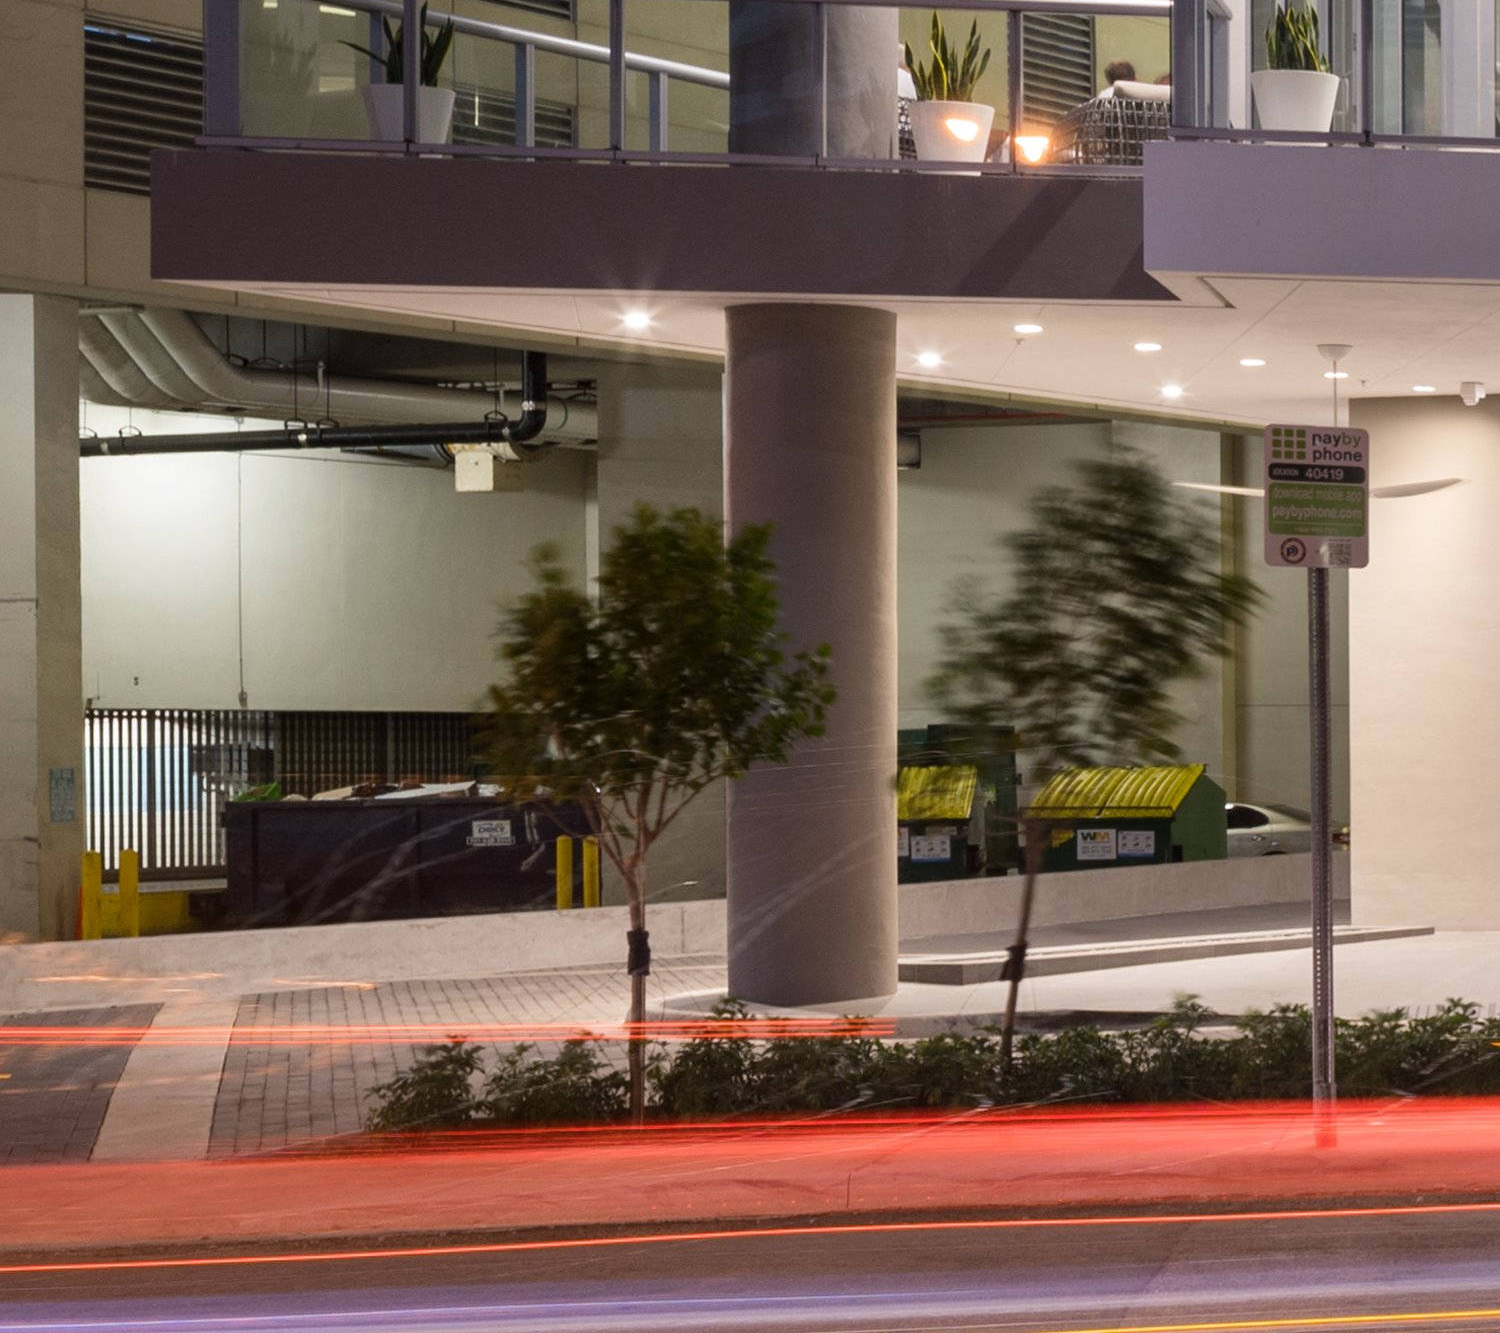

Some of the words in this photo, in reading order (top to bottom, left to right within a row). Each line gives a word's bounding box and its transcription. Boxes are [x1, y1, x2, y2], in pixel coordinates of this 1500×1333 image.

[1312, 432, 1361, 447] payby
[1313, 448, 1362, 462] phone
[1305, 468, 1344, 480] 40419
[1272, 505, 1362, 520] paybyphone.com
